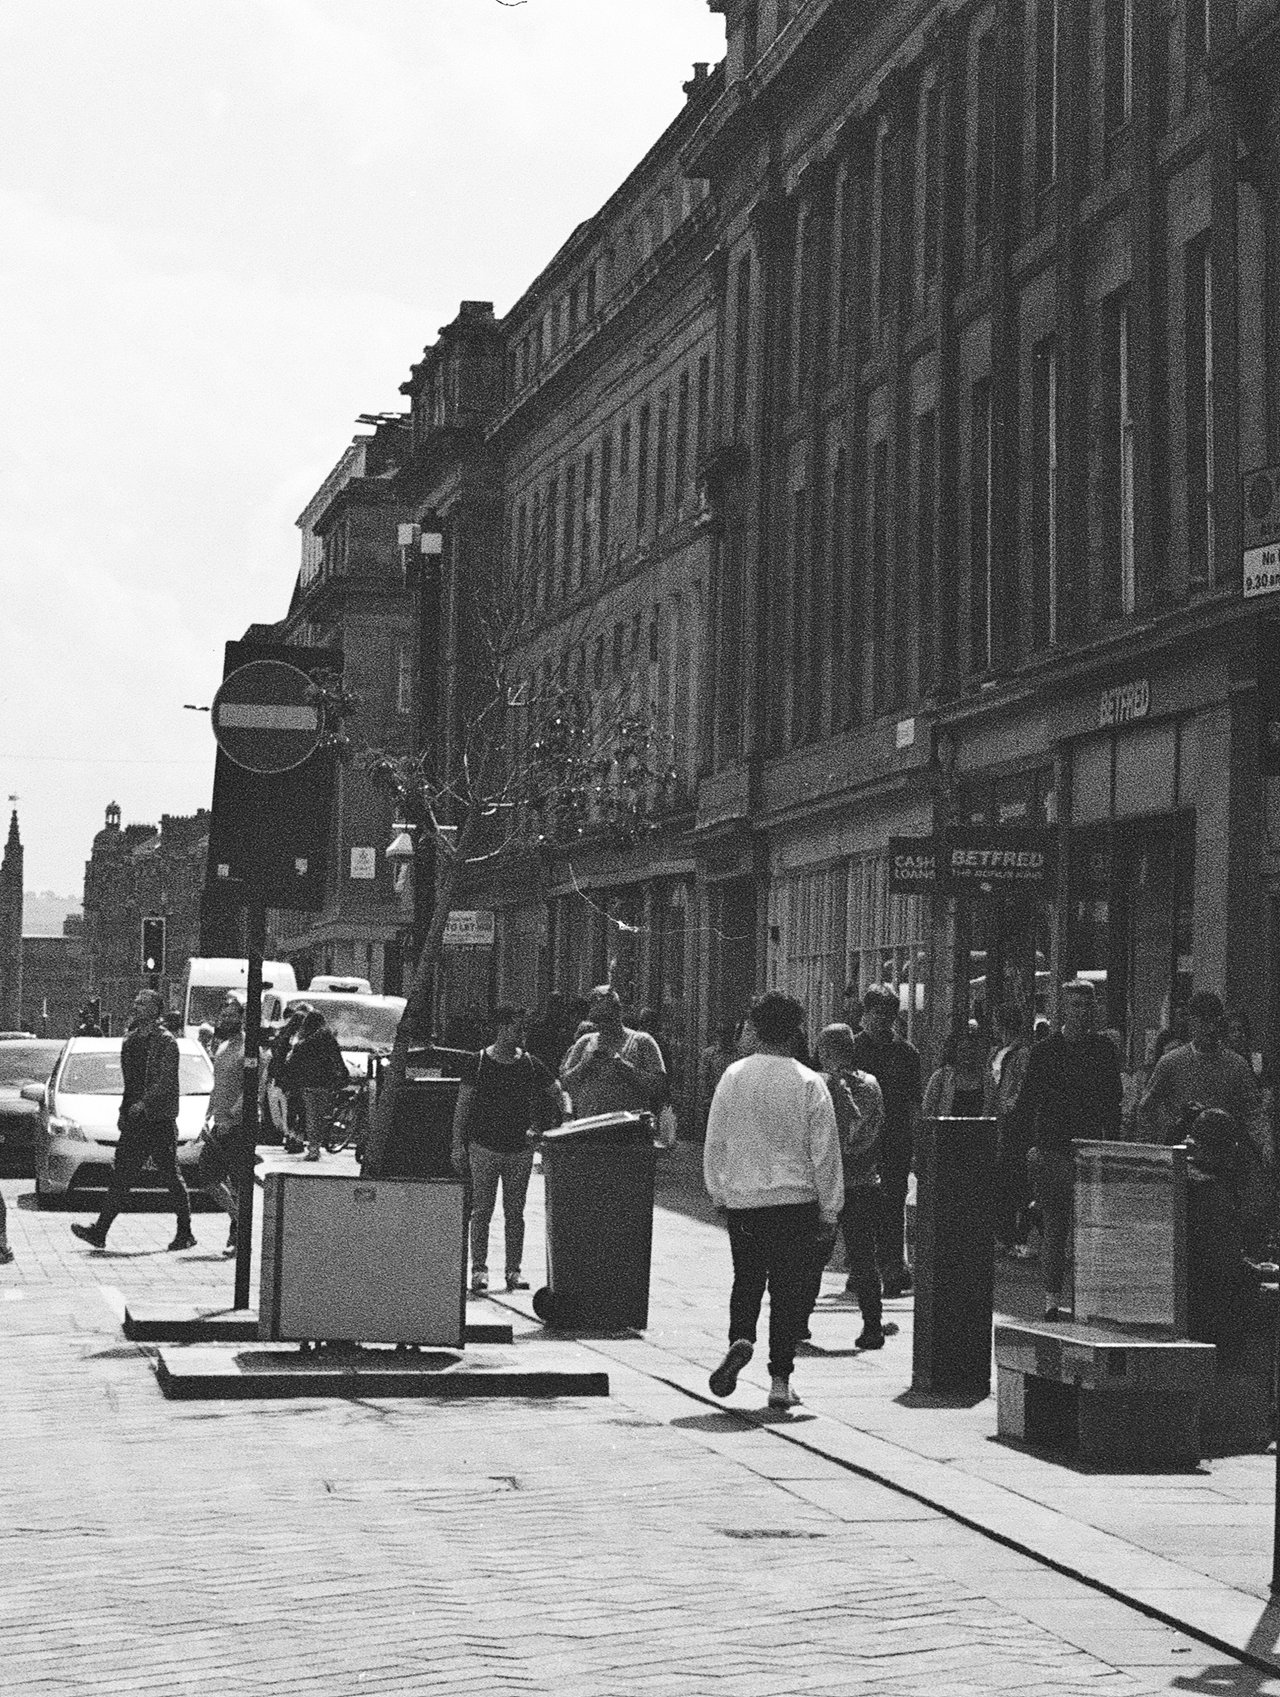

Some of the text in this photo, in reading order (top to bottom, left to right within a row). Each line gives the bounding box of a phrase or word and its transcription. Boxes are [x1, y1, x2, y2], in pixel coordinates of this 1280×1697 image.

[1100, 679, 1149, 726] BETFRED
[894, 855, 936, 868] CASH
[951, 849, 1044, 868] BETFRED
[894, 868, 936, 880] LOANS
